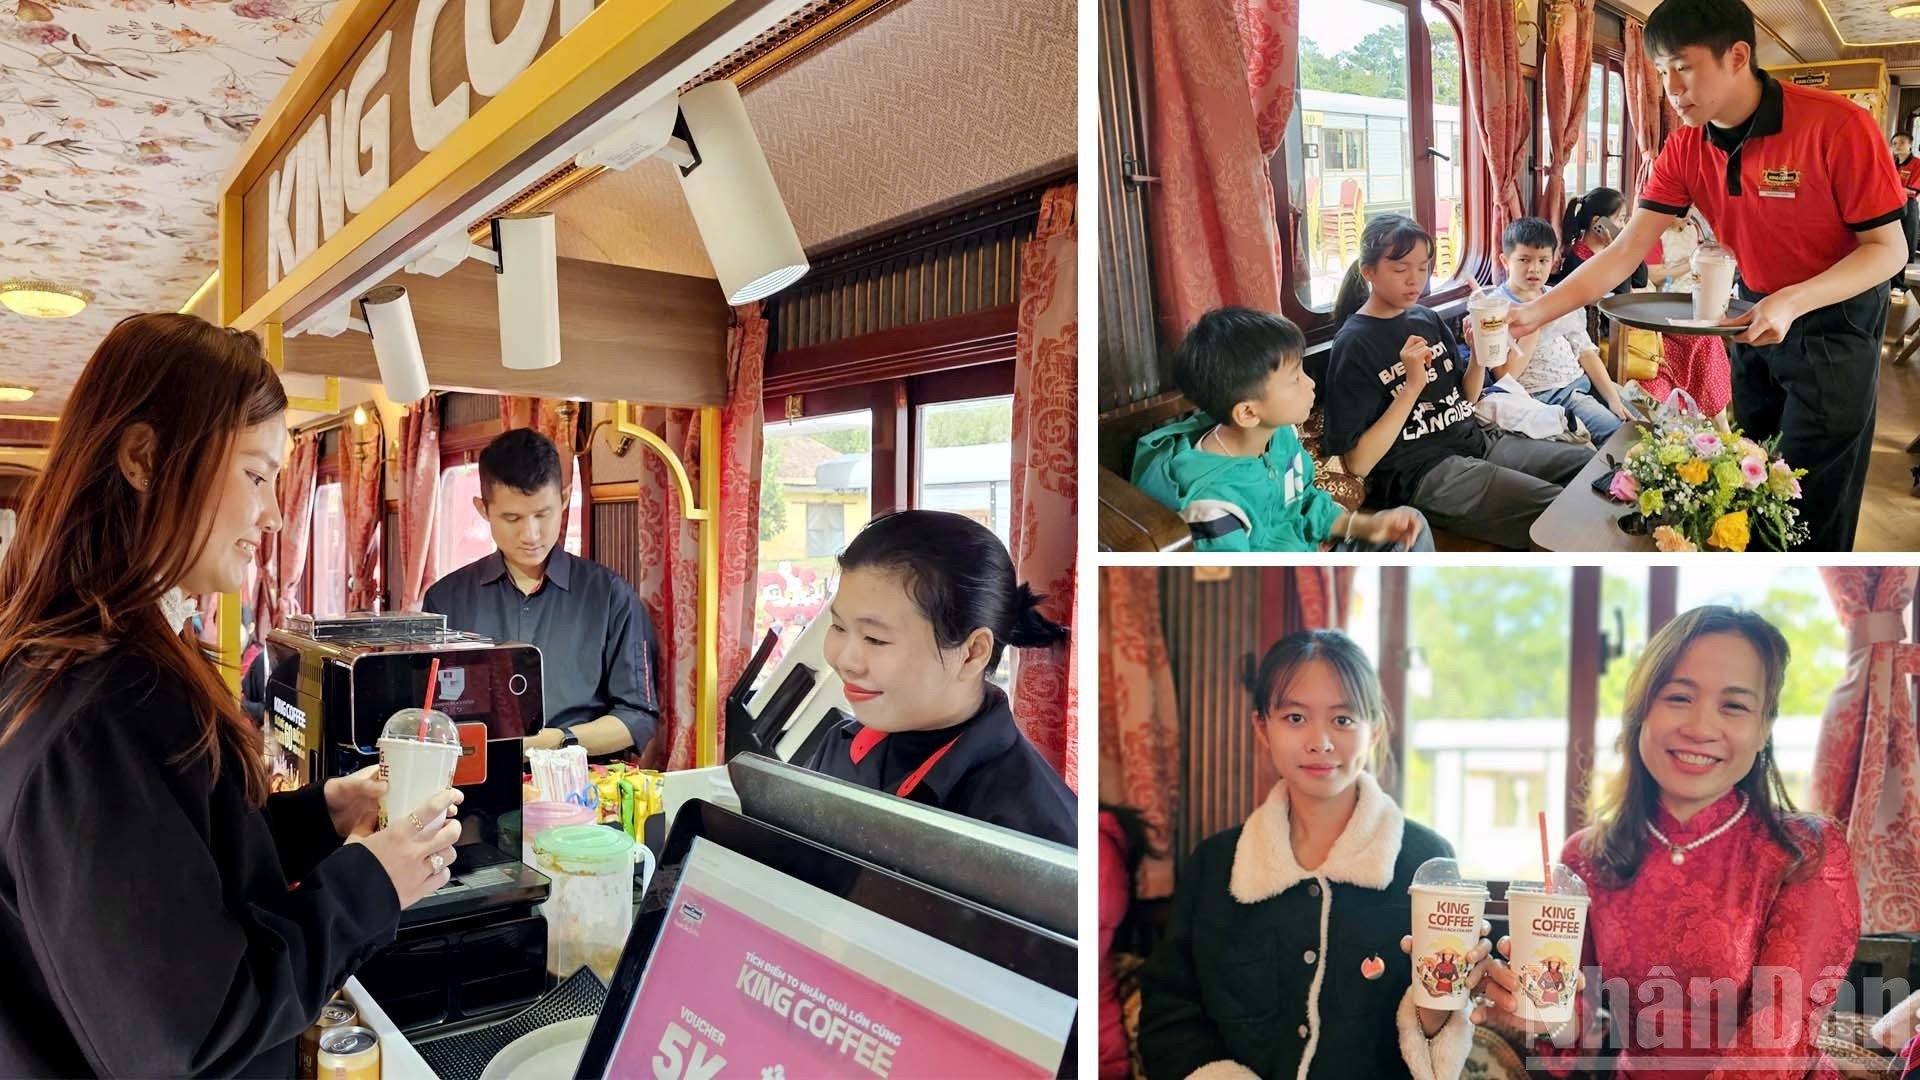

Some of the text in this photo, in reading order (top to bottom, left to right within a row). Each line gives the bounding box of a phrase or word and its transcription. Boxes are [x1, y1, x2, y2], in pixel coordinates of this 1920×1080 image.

[267, 30, 392, 290] KING
[286, 703, 306, 729] COFFEE
[1436, 901, 1470, 915] KING
[1542, 905, 1576, 920] KING
[1428, 913, 1474, 927] COFFEE
[1532, 919, 1580, 934] COFFEE
[787, 974, 799, 988] TO
[680, 1005, 726, 1047] VOUCHER
[735, 963, 897, 1080] KING COFFEE
